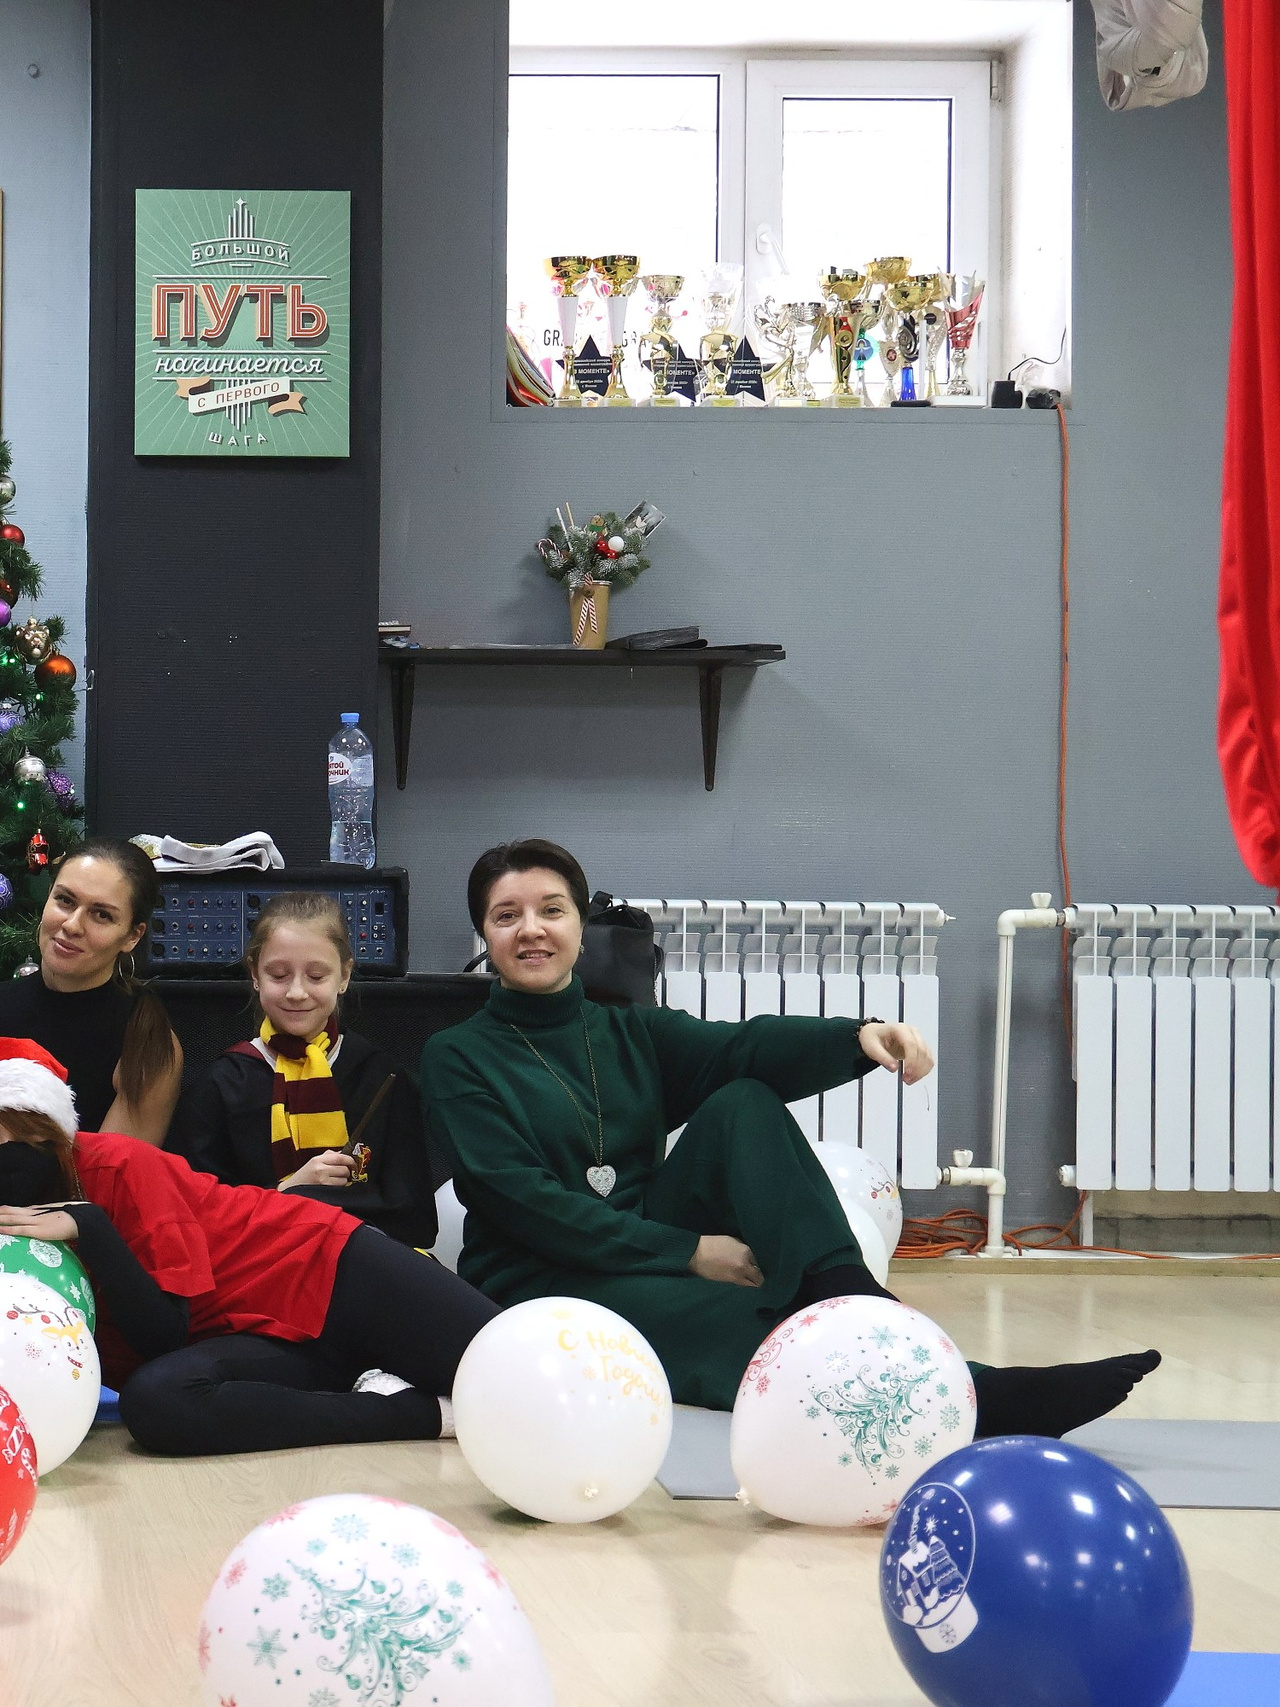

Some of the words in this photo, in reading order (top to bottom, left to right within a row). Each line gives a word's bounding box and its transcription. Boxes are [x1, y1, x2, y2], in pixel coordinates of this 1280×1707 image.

[192, 243, 291, 262] БОЛЬШОЙ
[152, 284, 328, 343] ПУТЬ
[155, 357, 325, 374] начинается
[197, 397, 206, 408] С
[216, 382, 280, 405] ПЕРВОГО
[208, 431, 269, 446] ШАГА
[558, 1329, 579, 1351] С
